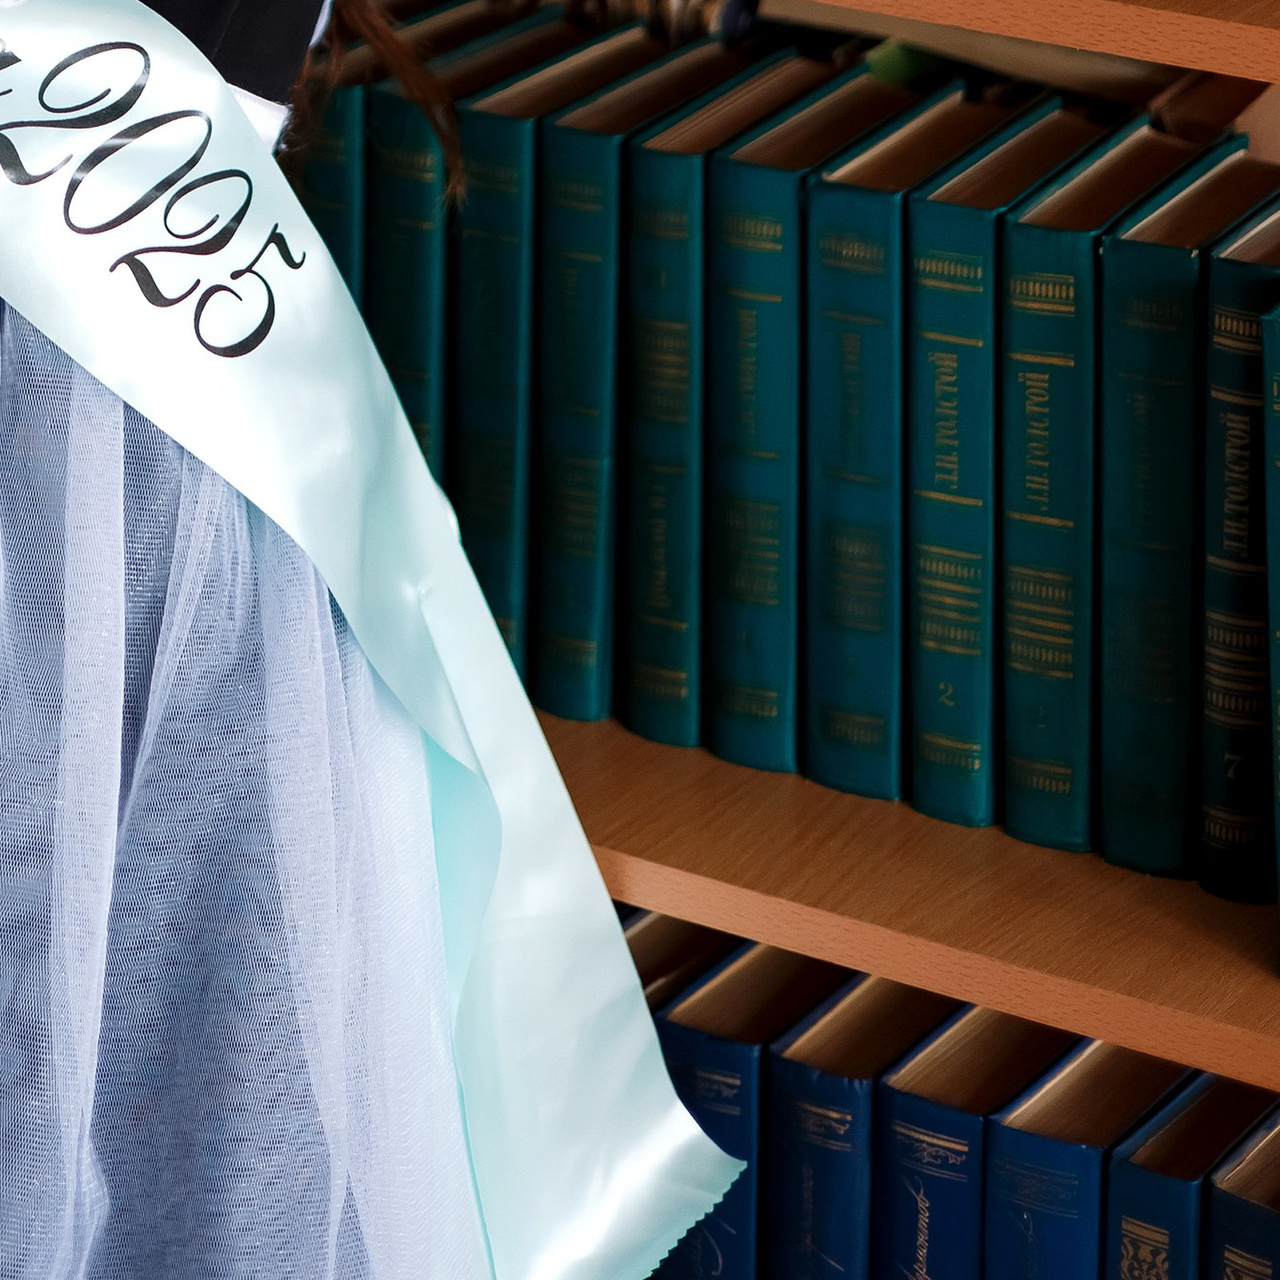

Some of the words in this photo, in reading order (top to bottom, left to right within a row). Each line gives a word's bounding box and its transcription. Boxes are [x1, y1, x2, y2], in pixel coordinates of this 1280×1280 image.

[928, 352, 959, 447] ТОЛСТОЙ
[1018, 372, 1050, 468] ТОЛСТОЙ
[1219, 412, 1251, 513] ТОЛСТОЙ
[938, 681, 955, 707] 2
[1224, 752, 1241, 779] 7
